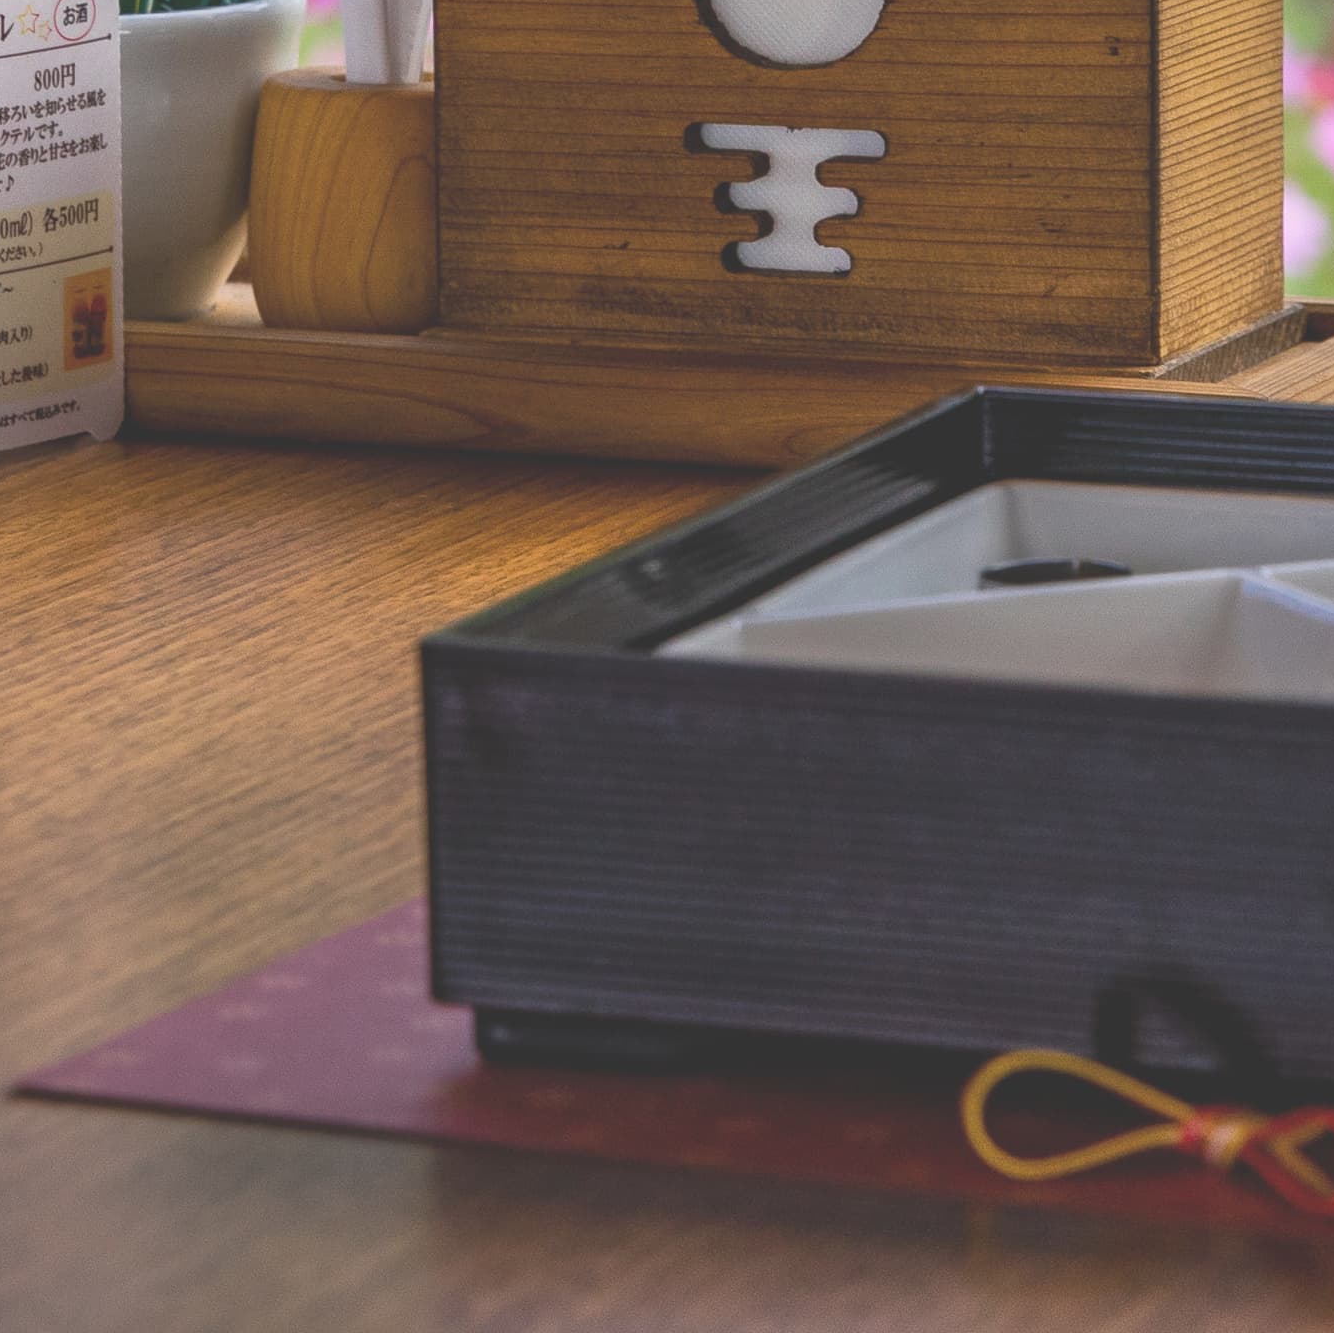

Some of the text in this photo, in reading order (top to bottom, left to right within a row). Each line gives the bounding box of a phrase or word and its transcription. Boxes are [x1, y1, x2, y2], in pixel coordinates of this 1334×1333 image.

[63, 2, 88, 26] お酒
[34, 63, 76, 91] 800円
[43, 198, 99, 233] 各500円
